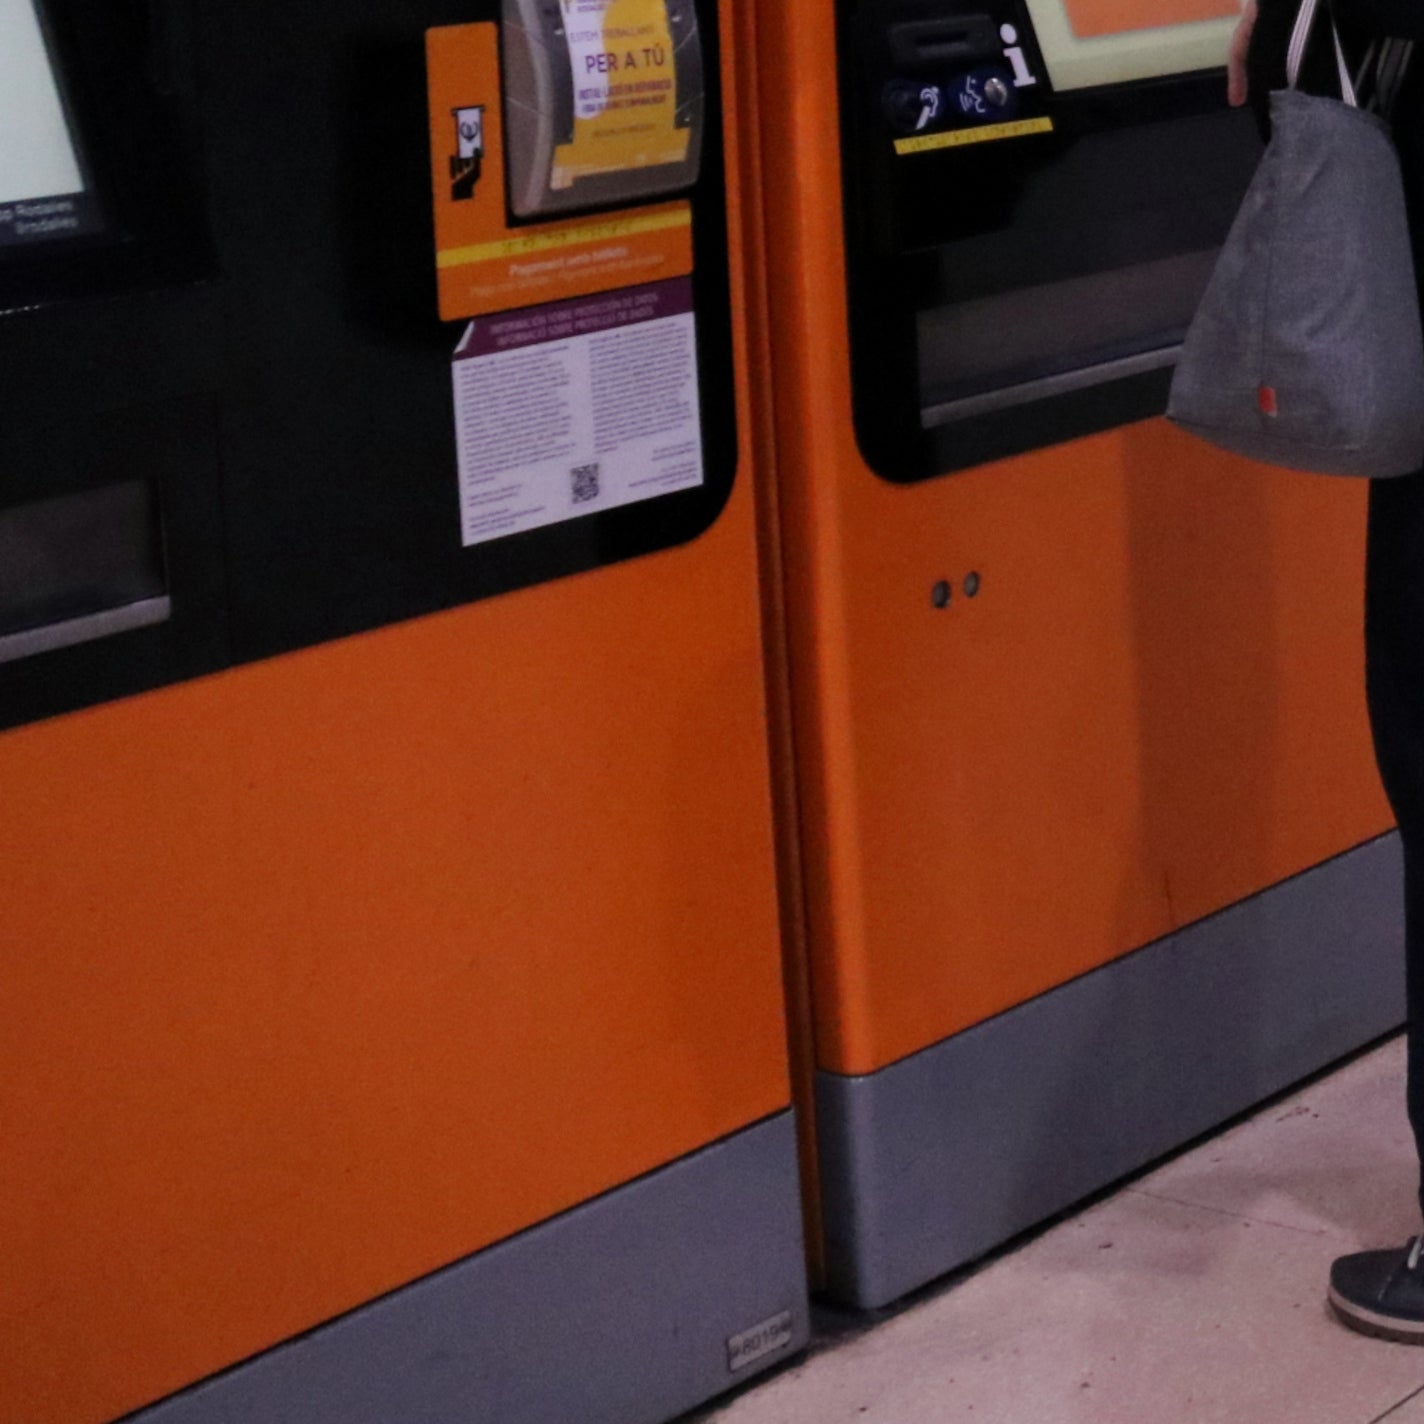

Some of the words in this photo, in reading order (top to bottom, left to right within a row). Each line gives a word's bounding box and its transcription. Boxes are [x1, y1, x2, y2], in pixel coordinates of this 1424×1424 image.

[585, 52, 620, 74] PER
[624, 53, 637, 70] A
[643, 42, 666, 68] TÚ
[507, 258, 565, 277] Pagament
